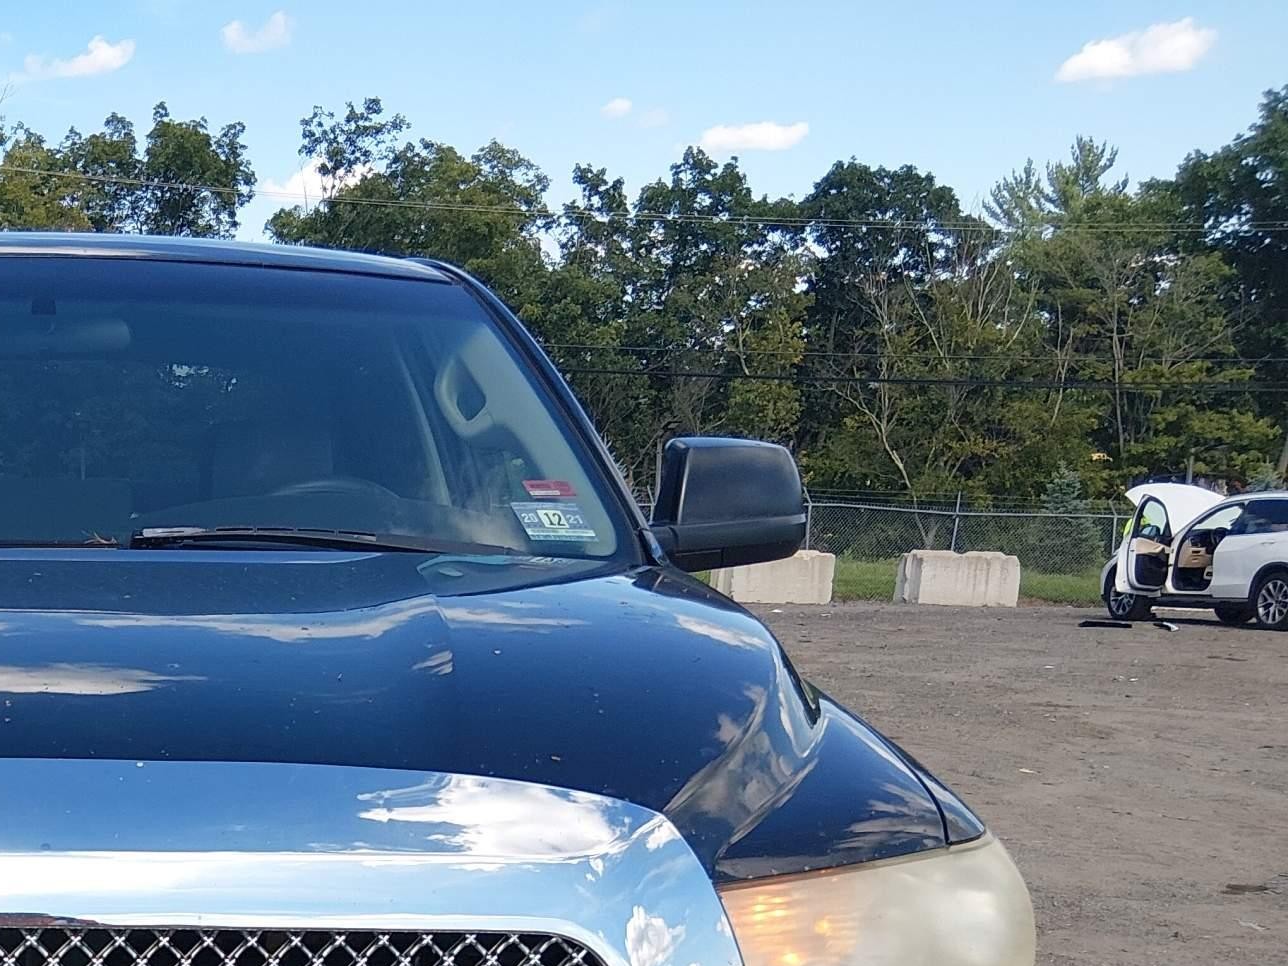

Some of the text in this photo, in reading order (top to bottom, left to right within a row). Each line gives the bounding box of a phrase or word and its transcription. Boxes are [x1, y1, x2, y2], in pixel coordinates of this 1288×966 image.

[521, 512, 583, 526] 20 12 21
